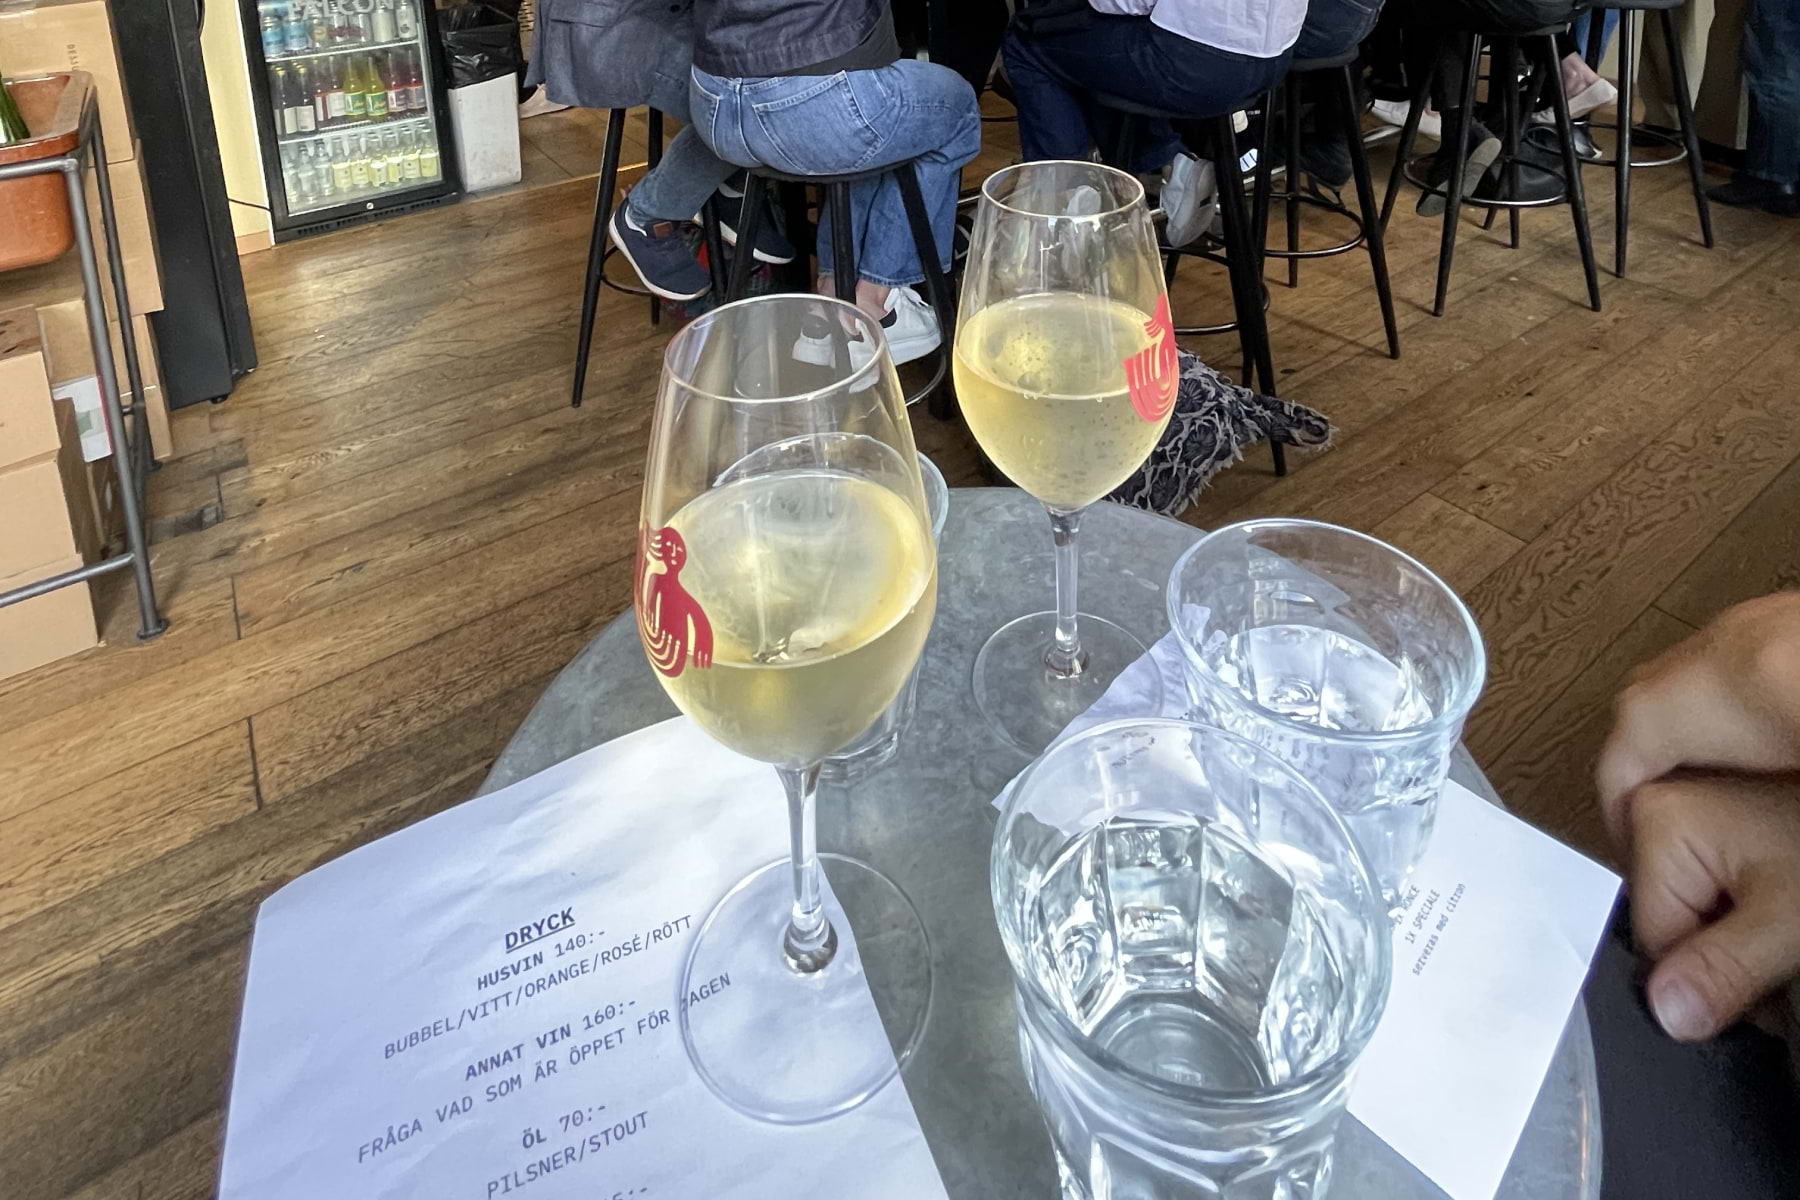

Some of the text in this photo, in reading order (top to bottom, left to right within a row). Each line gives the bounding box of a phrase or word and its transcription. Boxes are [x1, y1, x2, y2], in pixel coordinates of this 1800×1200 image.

[504, 906, 577, 951] DRYCK
[1411, 934, 1440, 977] serveras
[1445, 882, 1467, 914] citron
[1412, 888, 1441, 931] SPECIALE
[384, 914, 692, 1060] BUBBEL/VITT/ORANGE/ROSÉ/RÖTT
[477, 930, 606, 991] HUSVIN 140:-
[464, 1000, 636, 1082] ANNAT VIN 160:-
[357, 1117, 424, 1164] FRÅGA
[435, 1095, 474, 1124] VAD
[485, 1073, 523, 1103] SOM
[534, 1058, 558, 1084] ÄR
[568, 1027, 626, 1067] ÖPPET
[637, 1008, 672, 1036] FÖR
[521, 1104, 607, 1150] ÖL 70:-
[486, 1110, 649, 1200] PILSNER/STOUT
